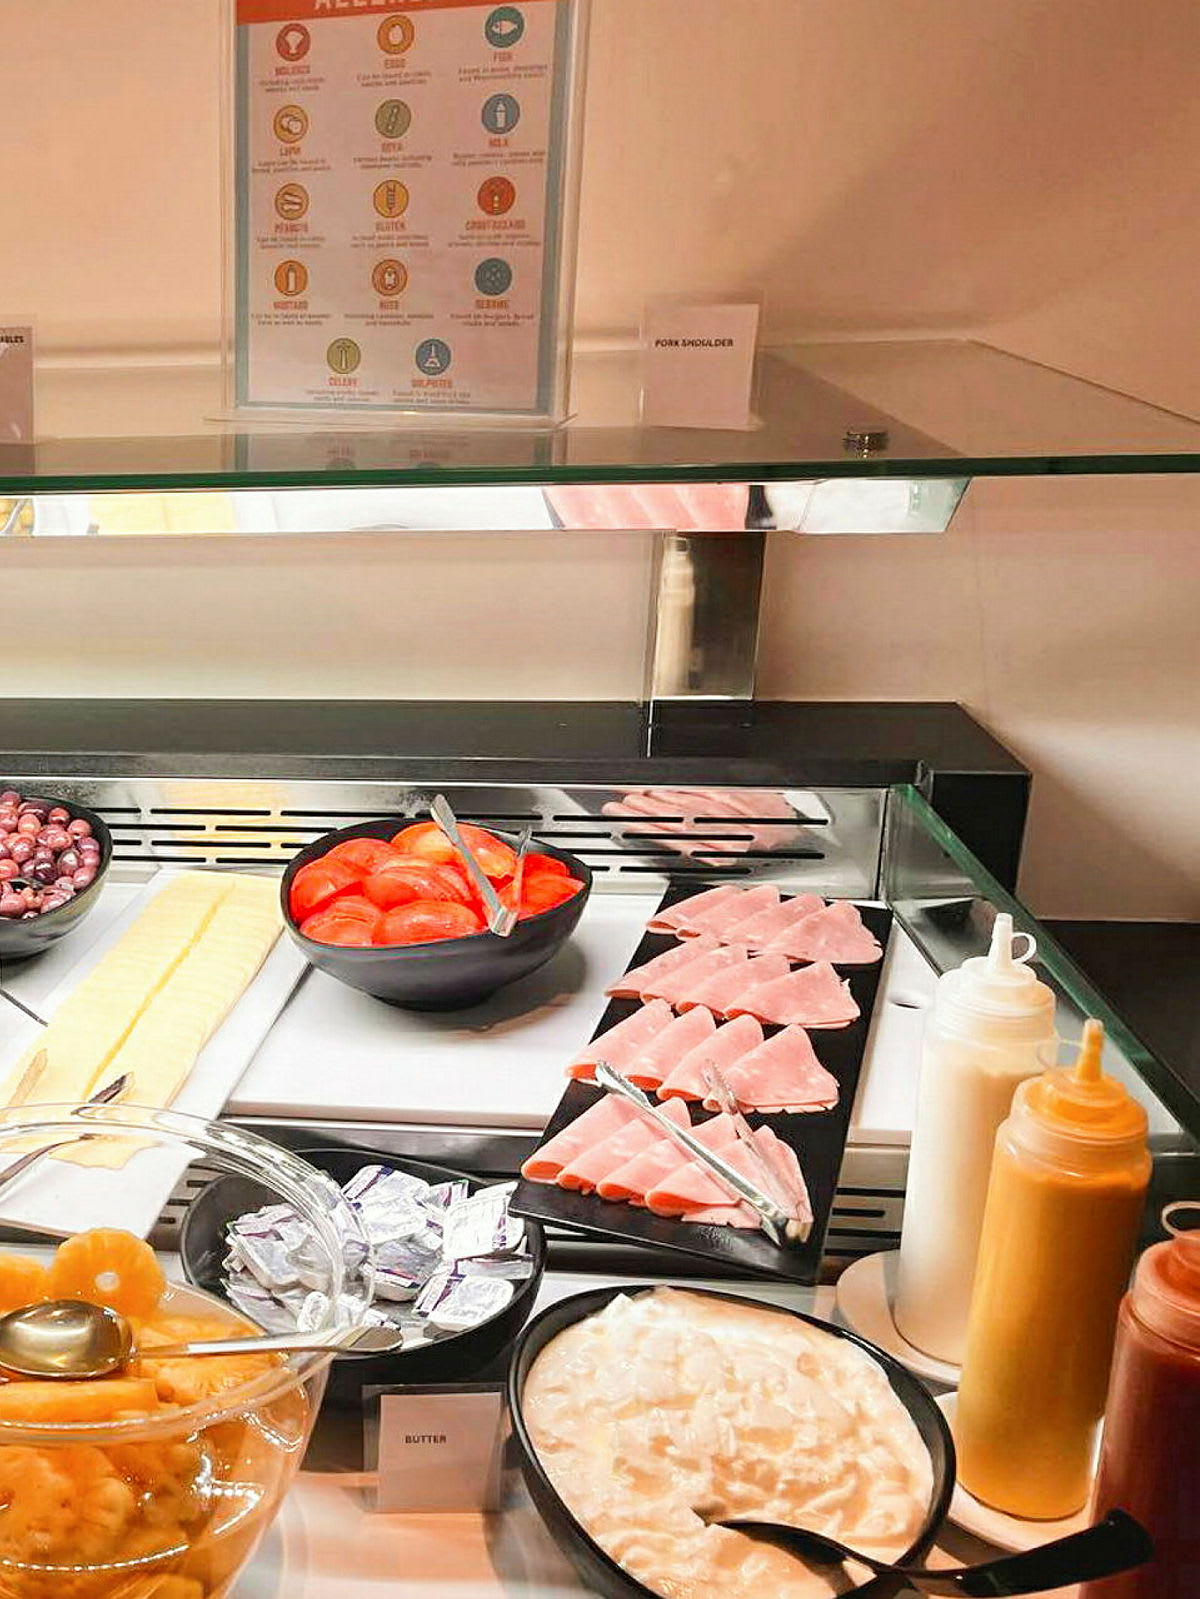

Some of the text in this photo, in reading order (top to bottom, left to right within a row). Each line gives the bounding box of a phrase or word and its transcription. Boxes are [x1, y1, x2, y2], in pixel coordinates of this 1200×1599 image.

[655, 339, 734, 347] PORK SHOULDER
[405, 1435, 446, 1443] BUTTER
